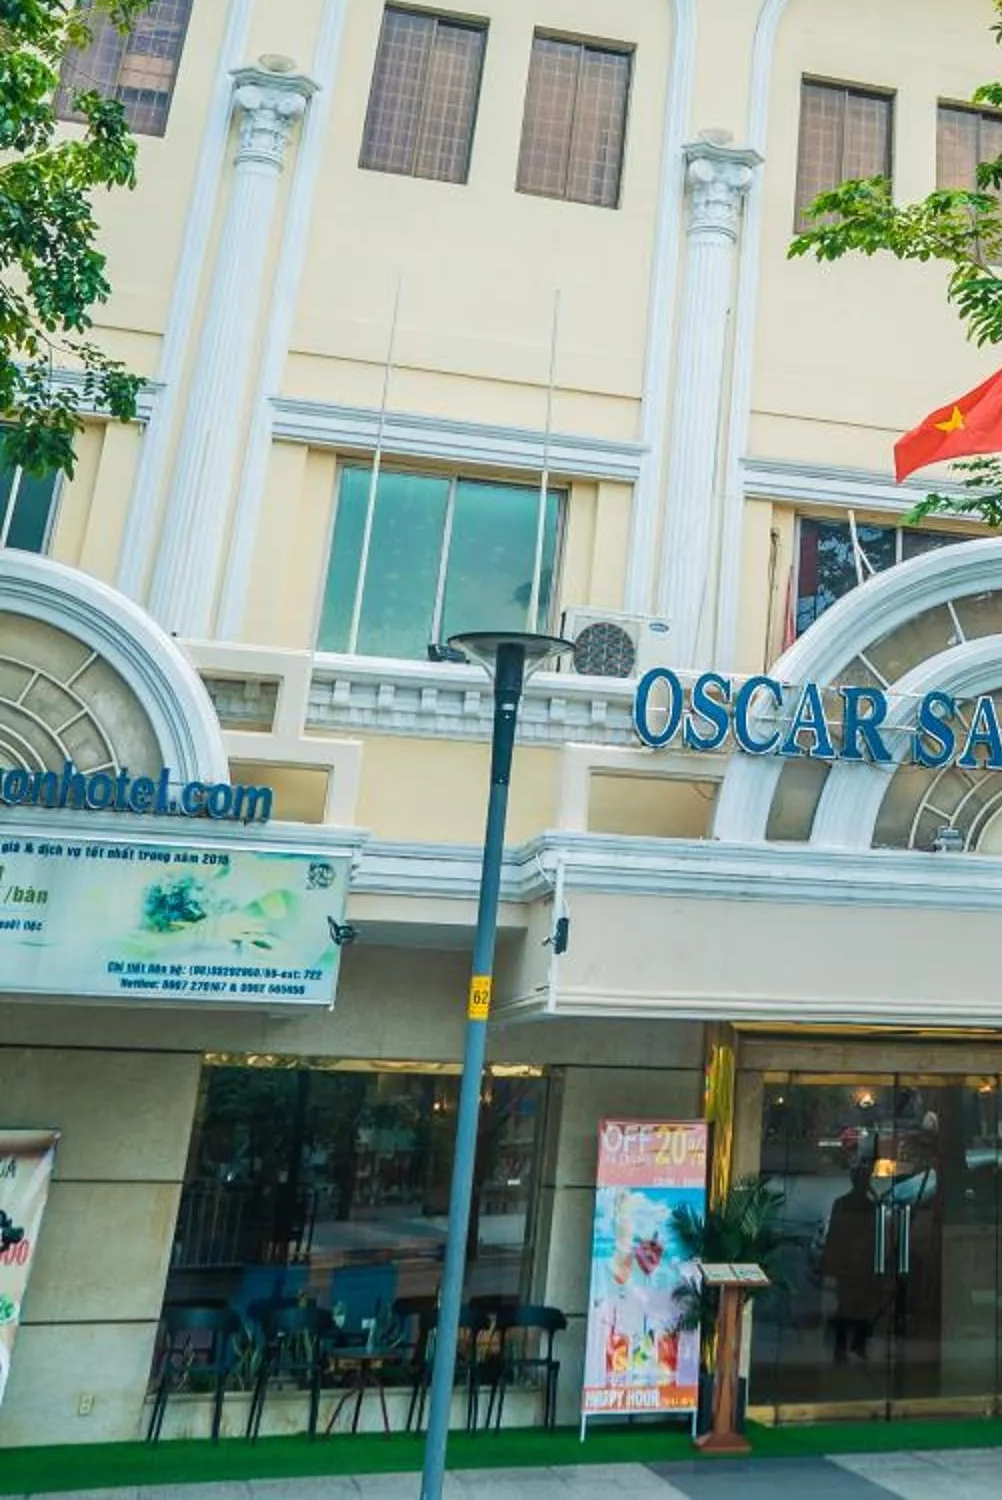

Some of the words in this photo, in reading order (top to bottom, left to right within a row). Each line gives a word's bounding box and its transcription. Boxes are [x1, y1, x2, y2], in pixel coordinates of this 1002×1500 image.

[632, 667, 894, 764] OSCAR
[0, 758, 274, 823] onhotel.com
[473, 989, 489, 1005] 62
[602, 1123, 652, 1154] OFF
